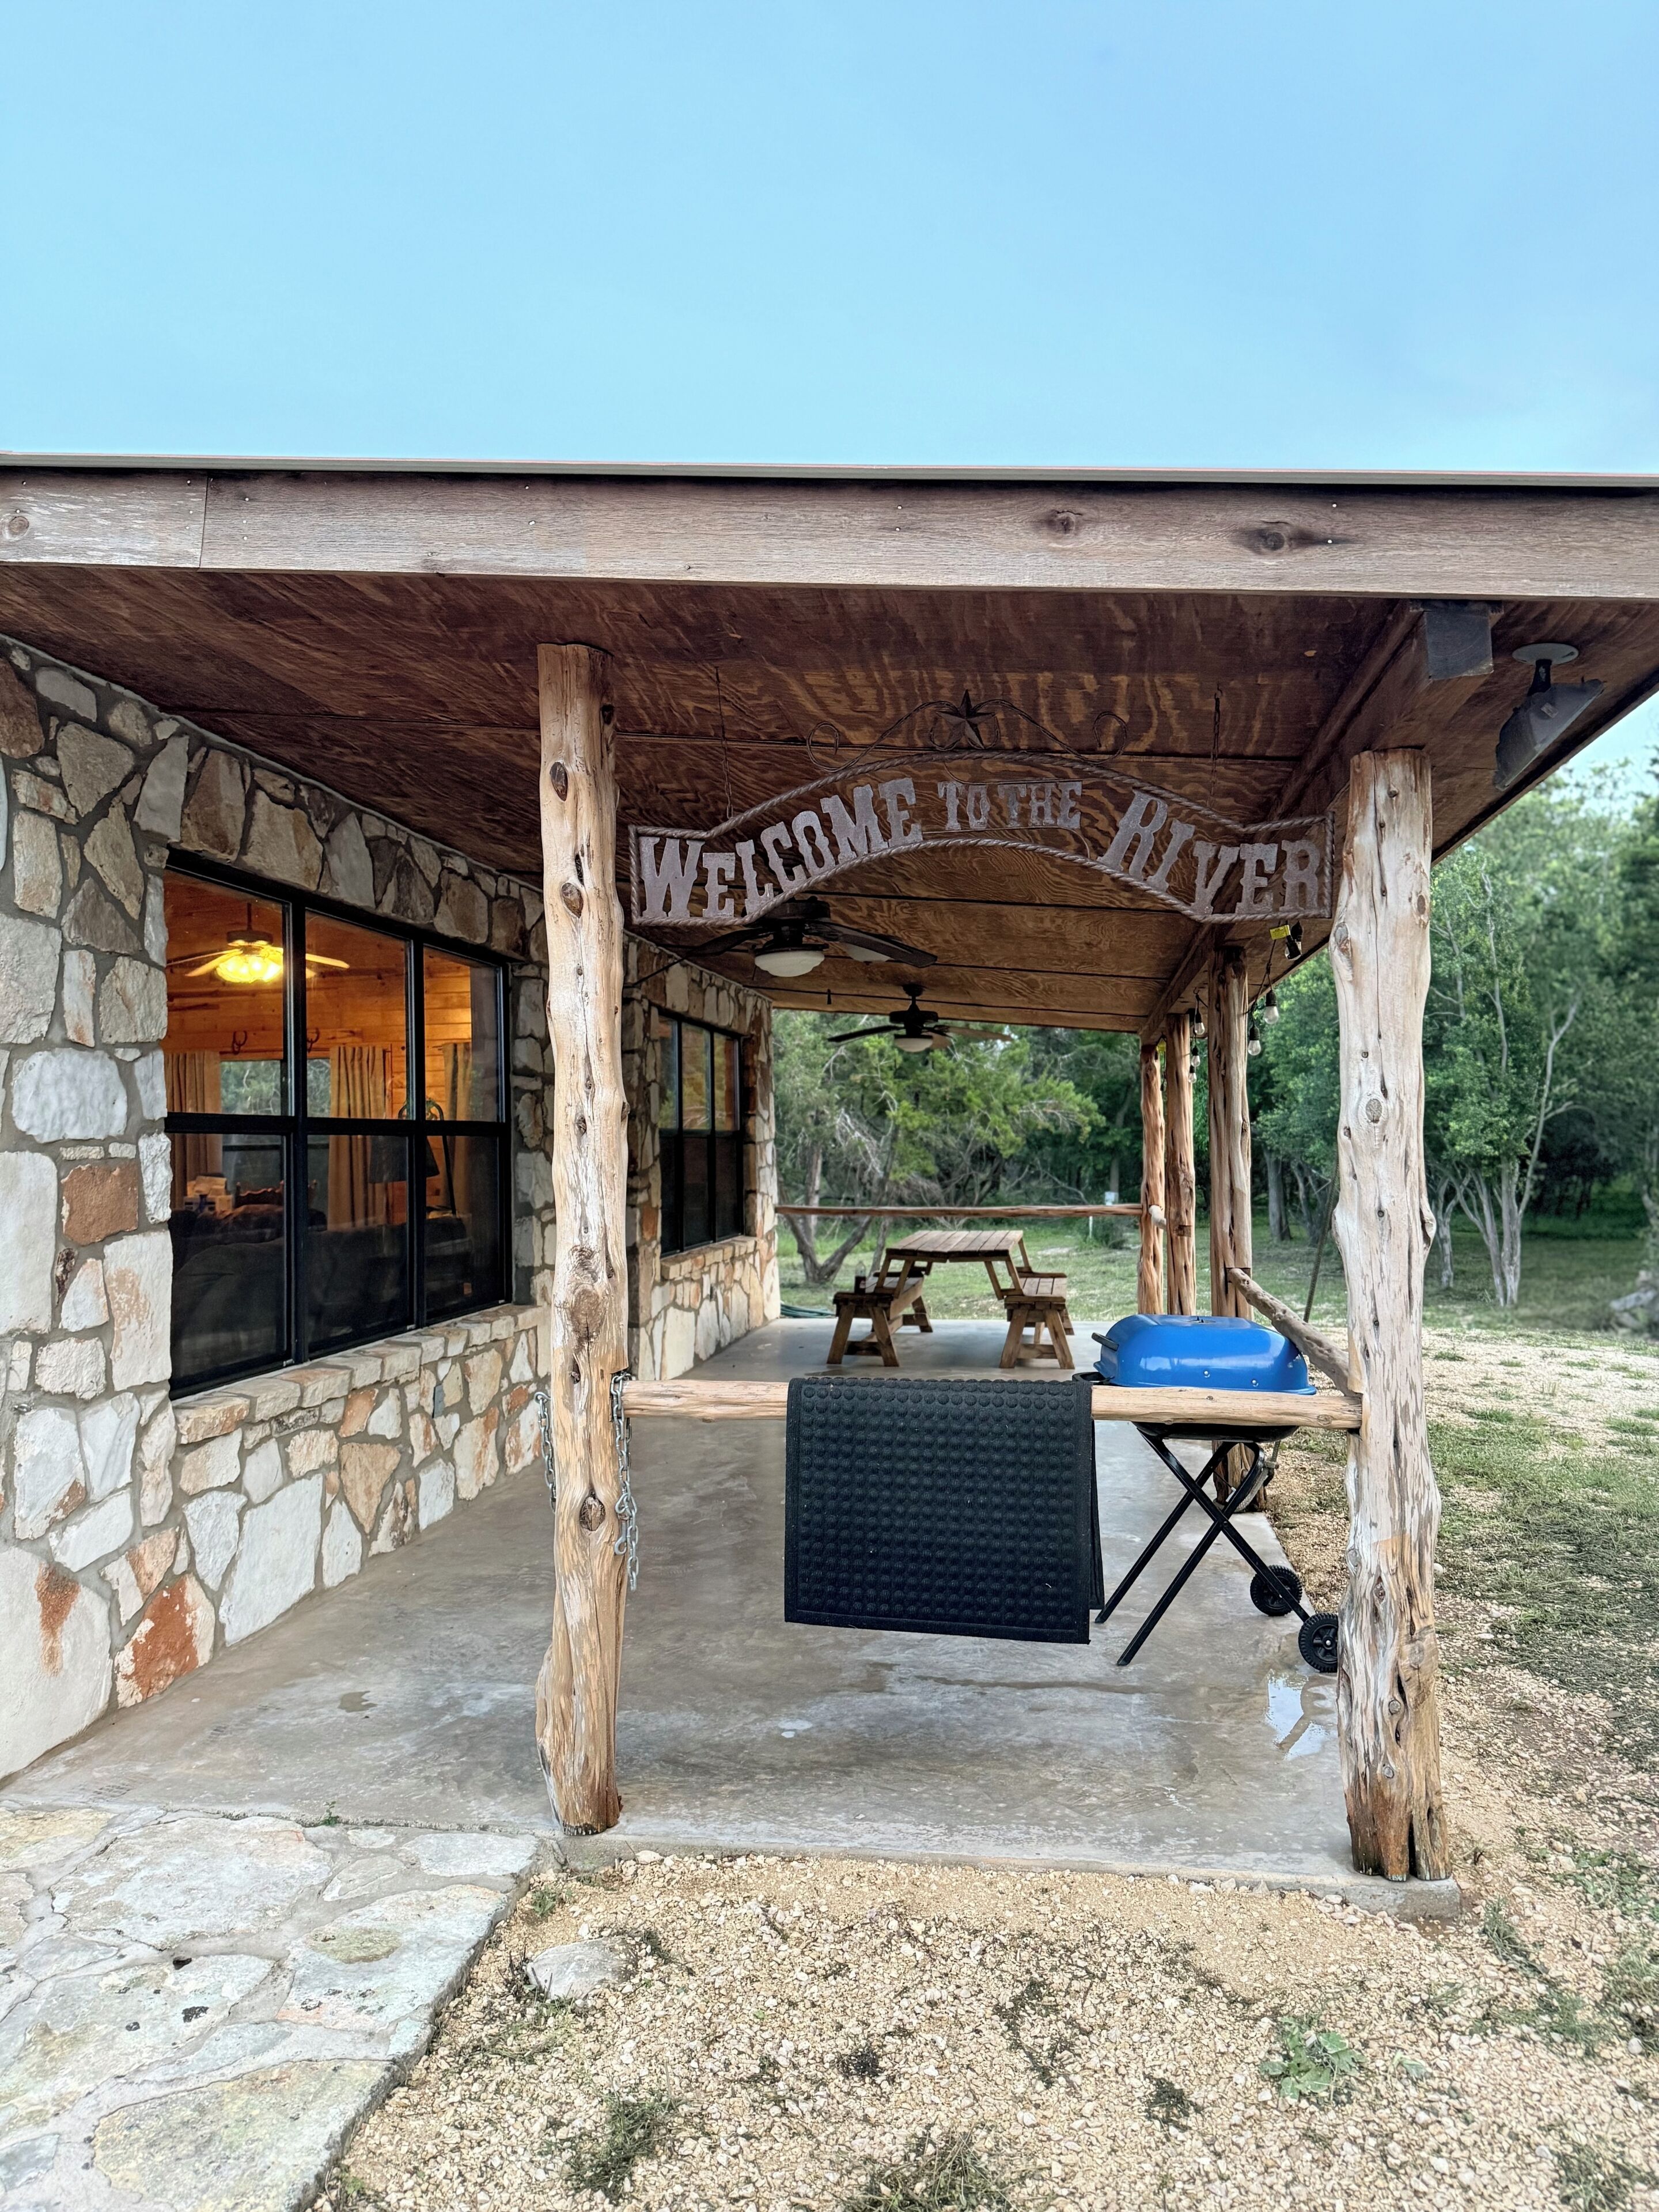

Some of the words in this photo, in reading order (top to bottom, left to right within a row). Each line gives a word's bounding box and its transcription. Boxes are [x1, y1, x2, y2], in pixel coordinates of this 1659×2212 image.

[639, 778, 923, 918] WELCOME
[937, 781, 990, 830] TO
[997, 781, 1082, 829] THE
[1097, 789, 1320, 915] RIVER
